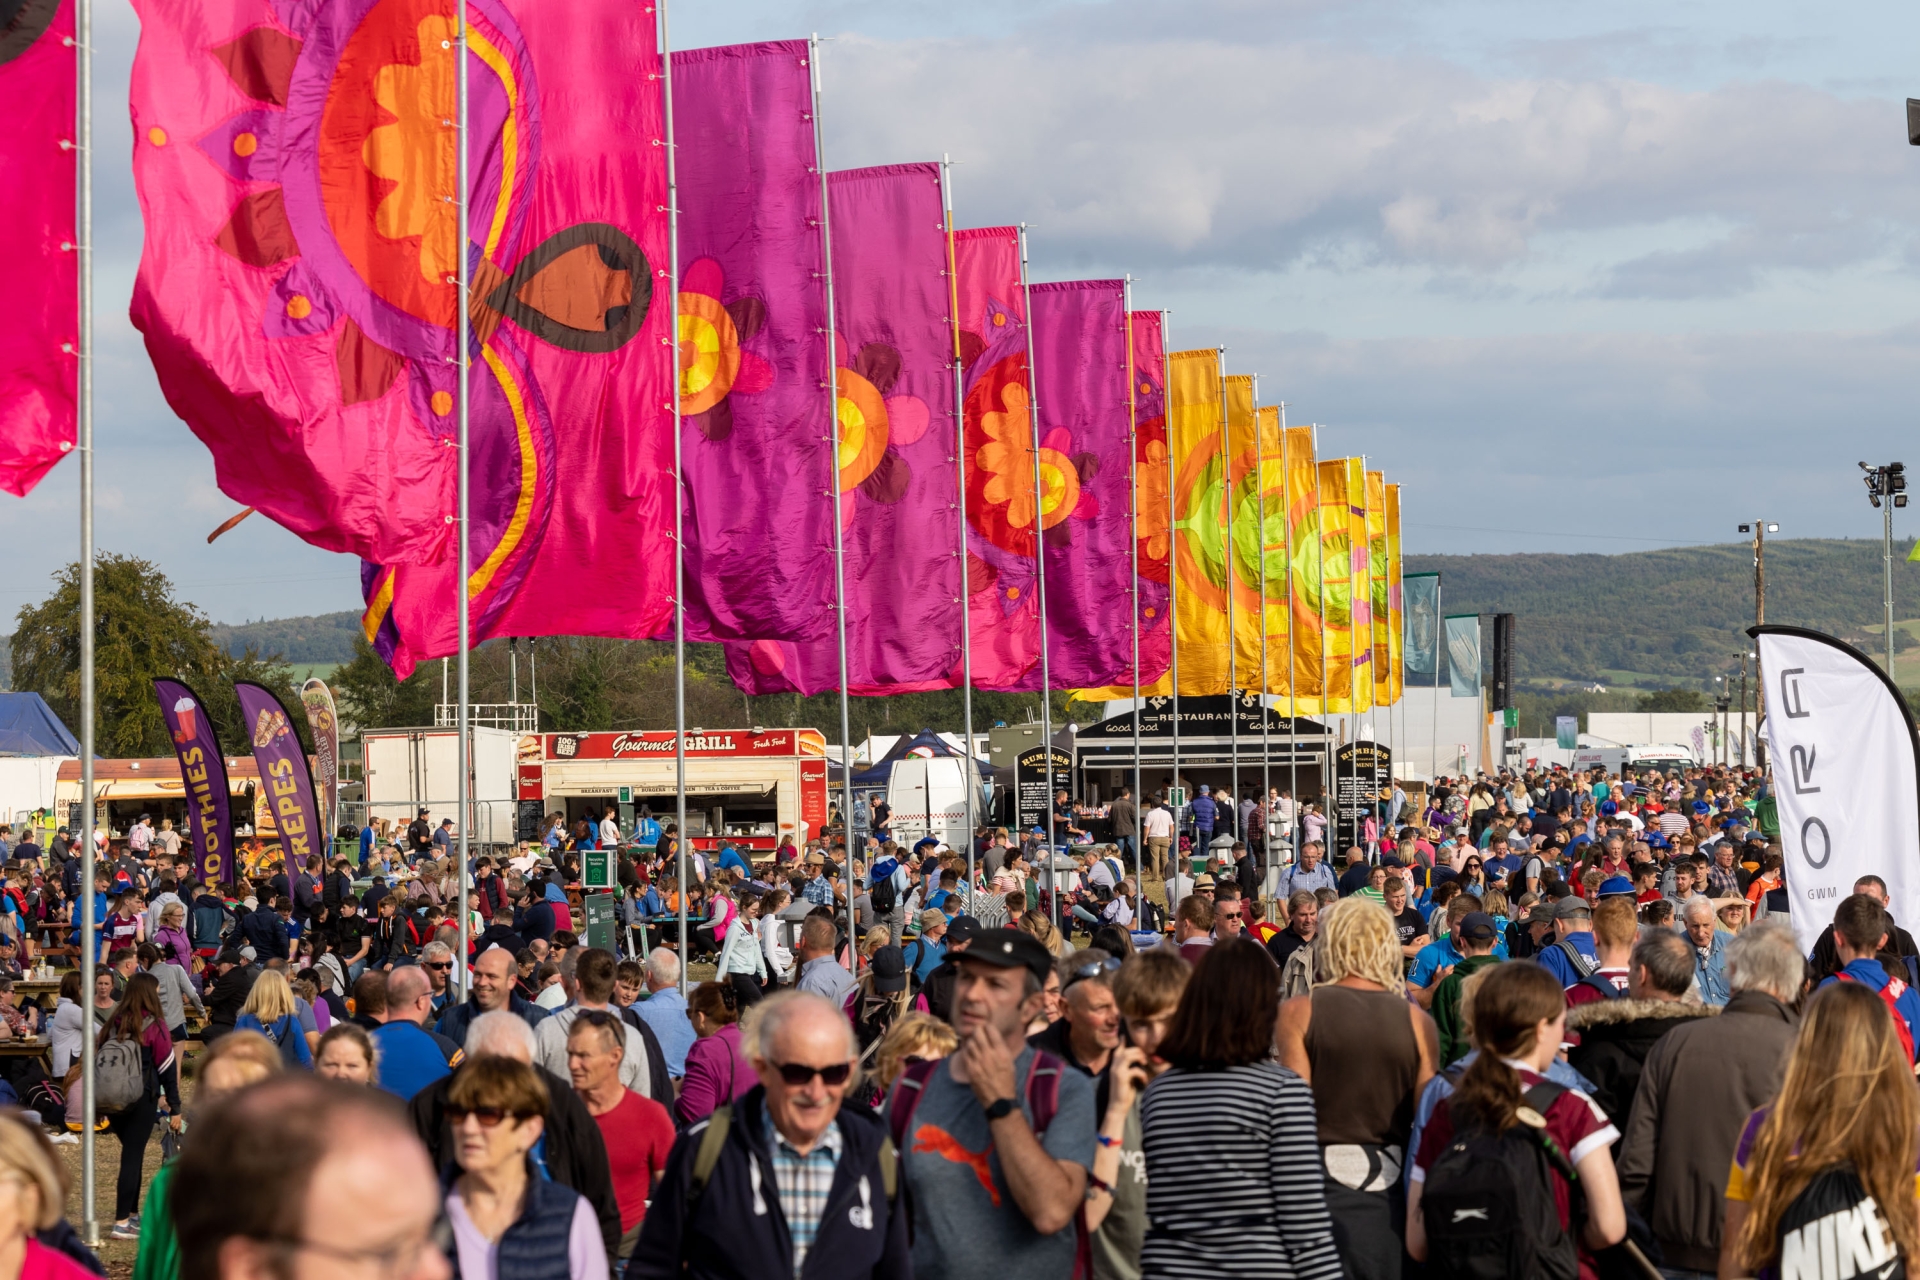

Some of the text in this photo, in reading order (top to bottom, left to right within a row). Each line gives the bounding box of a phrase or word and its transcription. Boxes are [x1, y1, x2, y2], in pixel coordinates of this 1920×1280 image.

[1160, 712, 1247, 721] RESTAURANTS
[1106, 723, 1159, 732] Good ood
[612, 733, 736, 758] Gourmet GRILL
[753, 736, 787, 750] Fresh Food
[520, 776, 541, 785] Gourmet
[182, 746, 222, 897] MOOTHIES
[1807, 886, 1837, 900] GWM
